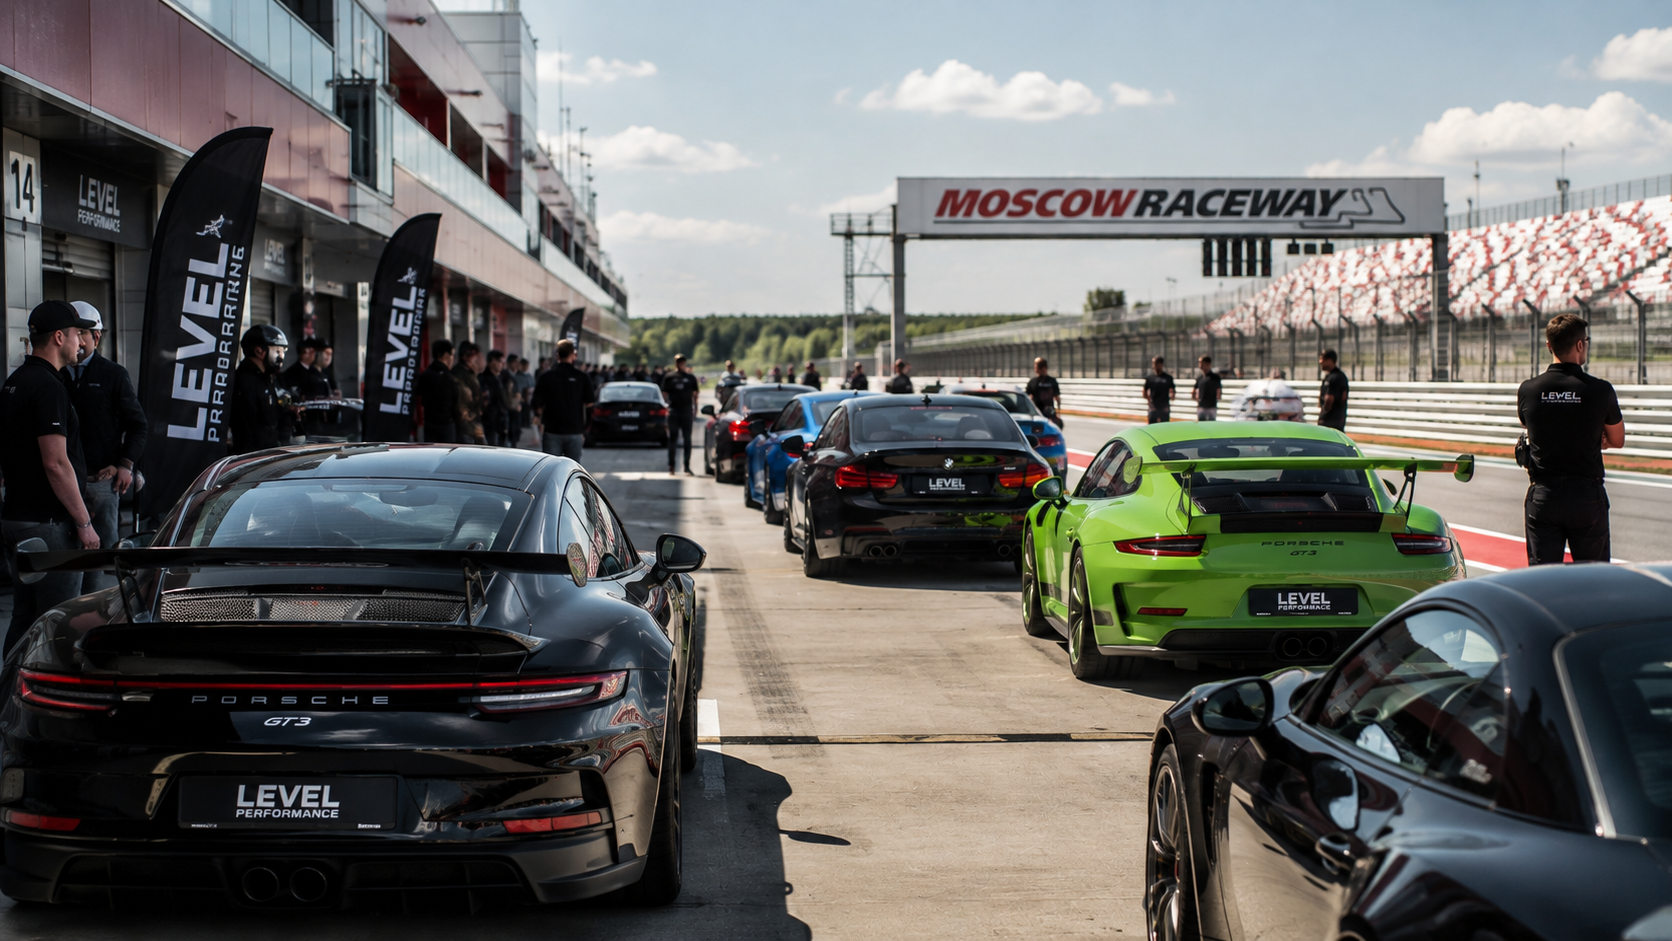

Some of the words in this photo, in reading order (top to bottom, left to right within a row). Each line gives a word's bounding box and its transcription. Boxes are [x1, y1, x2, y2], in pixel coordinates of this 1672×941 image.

[11, 158, 35, 213] 14
[78, 174, 121, 217] LEVEL
[167, 242, 229, 441] LEVEL
[379, 285, 418, 414] LEVEL
[928, 478, 965, 488] LEVEL
[1278, 592, 1331, 605] LEVEL
[191, 695, 389, 705] PORSCHE
[263, 717, 312, 727] GT3
[236, 784, 340, 808] LEVEL
[235, 808, 340, 819] PERFORMANCE
